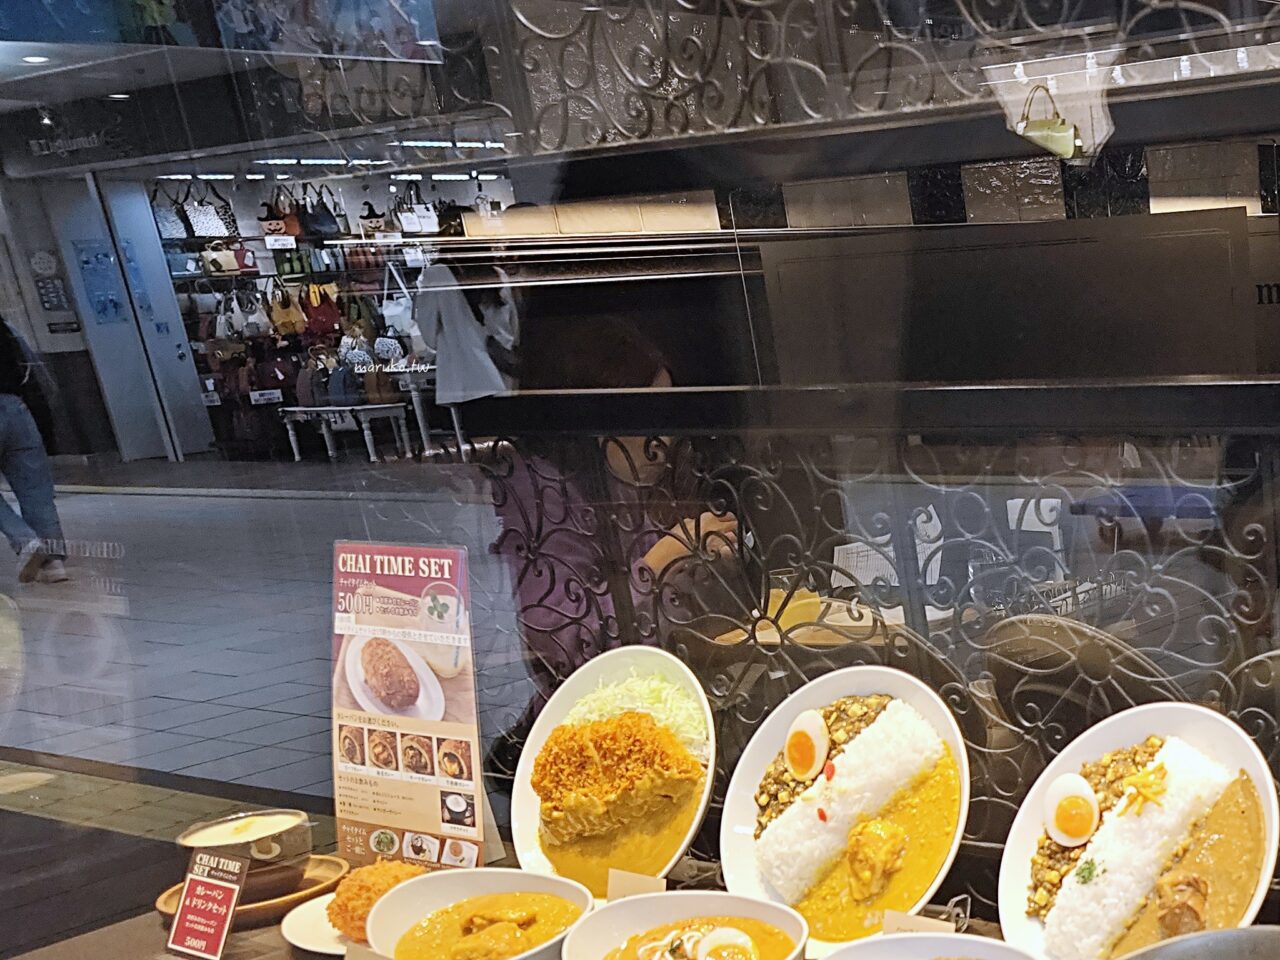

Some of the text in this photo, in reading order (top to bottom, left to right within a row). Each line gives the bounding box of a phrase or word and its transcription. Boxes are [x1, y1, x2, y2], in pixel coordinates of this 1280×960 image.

[338, 553, 453, 578] CHAI TIME SET
[338, 592, 374, 616] 500円
[192, 864, 211, 877] SET
[196, 853, 242, 874] CHAI TIME
[195, 885, 225, 901] カレーパン
[191, 897, 227, 916] ドリンクセット
[184, 936, 207, 951] 500円
